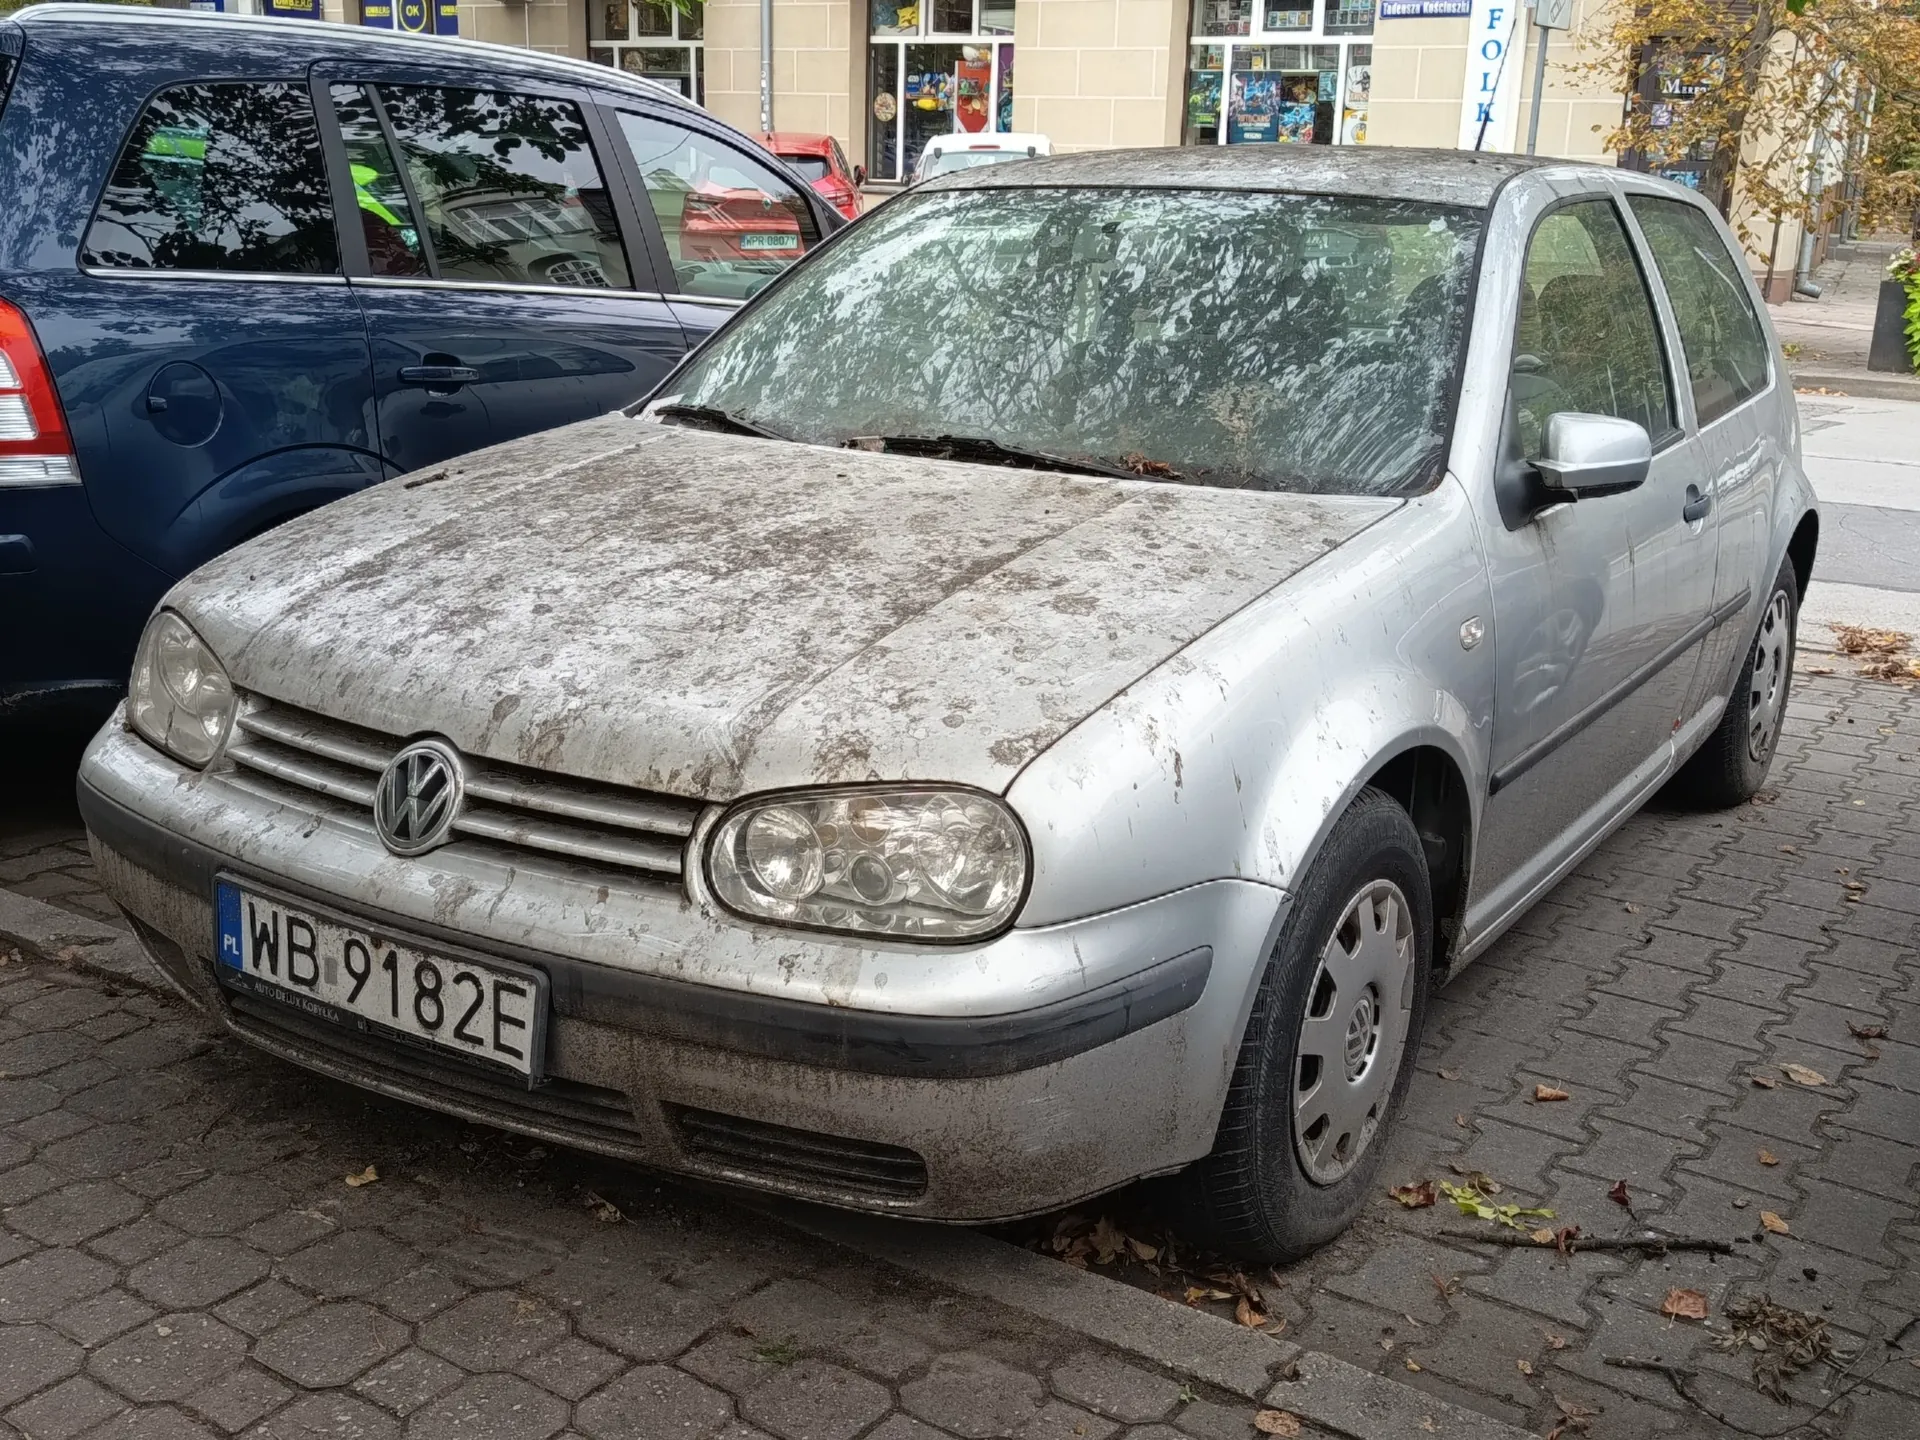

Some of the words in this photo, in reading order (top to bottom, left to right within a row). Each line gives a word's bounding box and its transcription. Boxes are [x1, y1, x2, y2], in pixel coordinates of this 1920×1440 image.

[405, 5, 420, 16] OK
[1383, 2, 1420, 15] Tadeusza
[1423, 1, 1470, 14] Kościuszki
[1476, 8, 1504, 122] FOLK
[746, 235, 765, 246] WPR
[767, 235, 796, 246] 0807Y
[223, 933, 240, 955] PL
[248, 901, 320, 987] WB
[343, 938, 527, 1061] 9182E
[254, 981, 276, 998] AUTO
